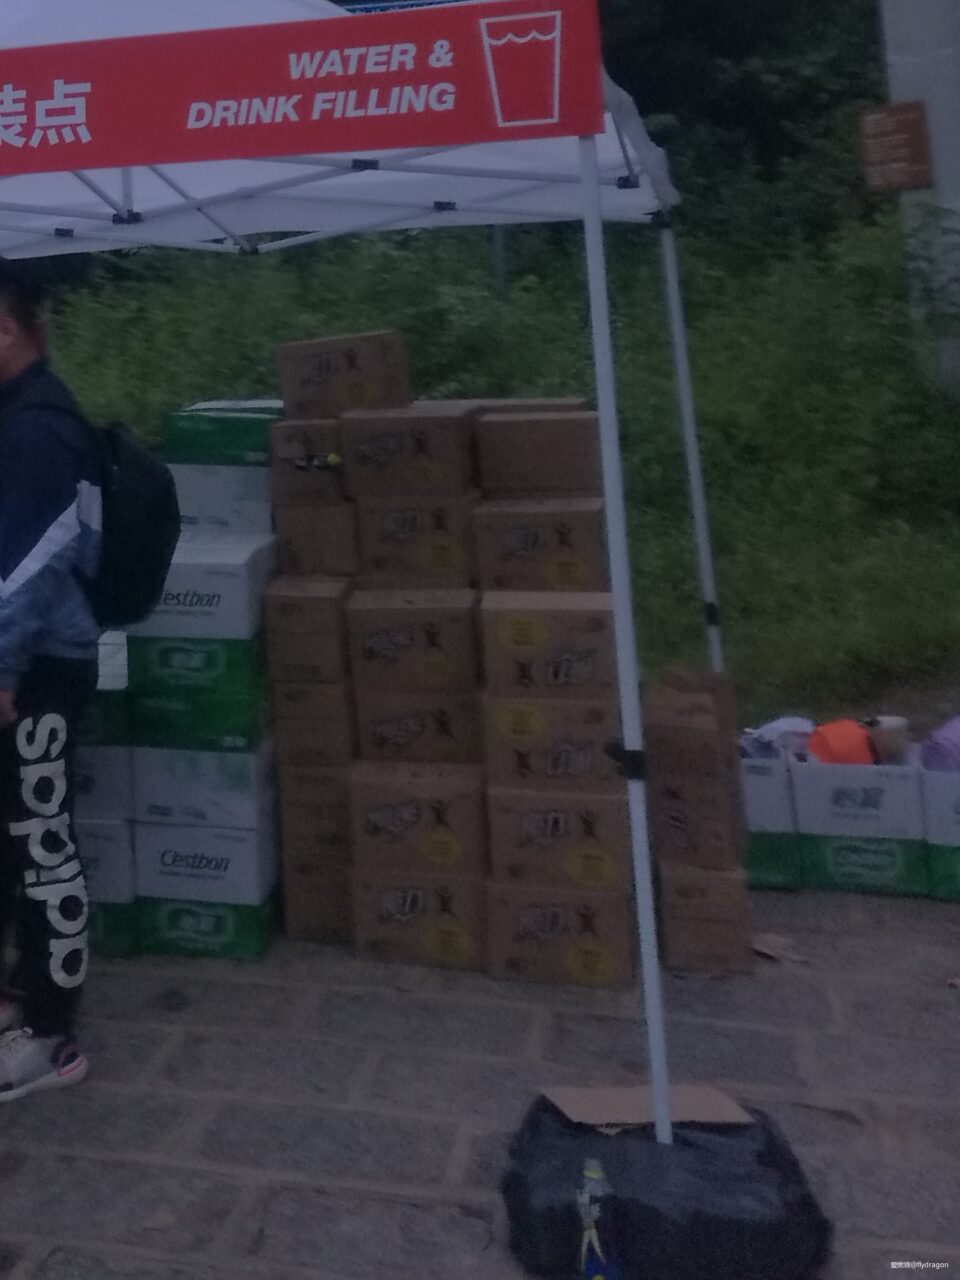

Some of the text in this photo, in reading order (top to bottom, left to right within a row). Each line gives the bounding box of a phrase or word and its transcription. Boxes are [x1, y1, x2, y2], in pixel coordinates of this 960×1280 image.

[288, 38, 454, 80] WATER &
[186, 82, 456, 130] DRINK FILLING
[160, 589, 221, 608] estbon
[8, 711, 89, 989] adidas
